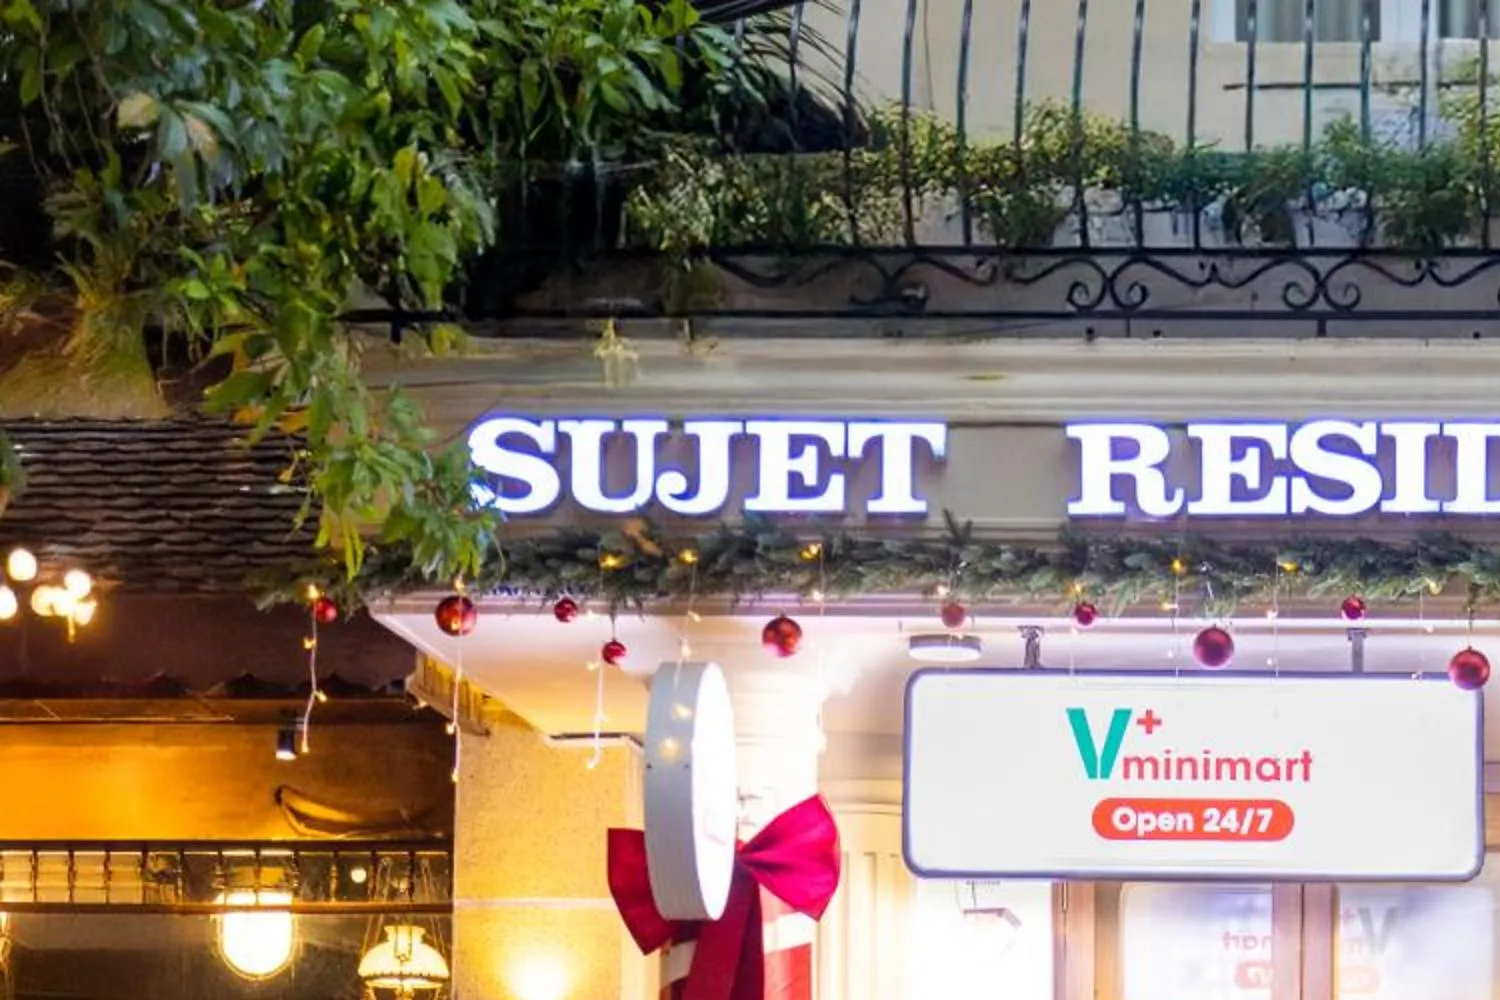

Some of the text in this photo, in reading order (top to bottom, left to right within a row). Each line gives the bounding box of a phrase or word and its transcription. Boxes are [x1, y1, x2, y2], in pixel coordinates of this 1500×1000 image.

[467, 417, 949, 515] SUJET
[1122, 749, 1313, 782] minimart
[1111, 806, 1273, 836] Open 24/7
